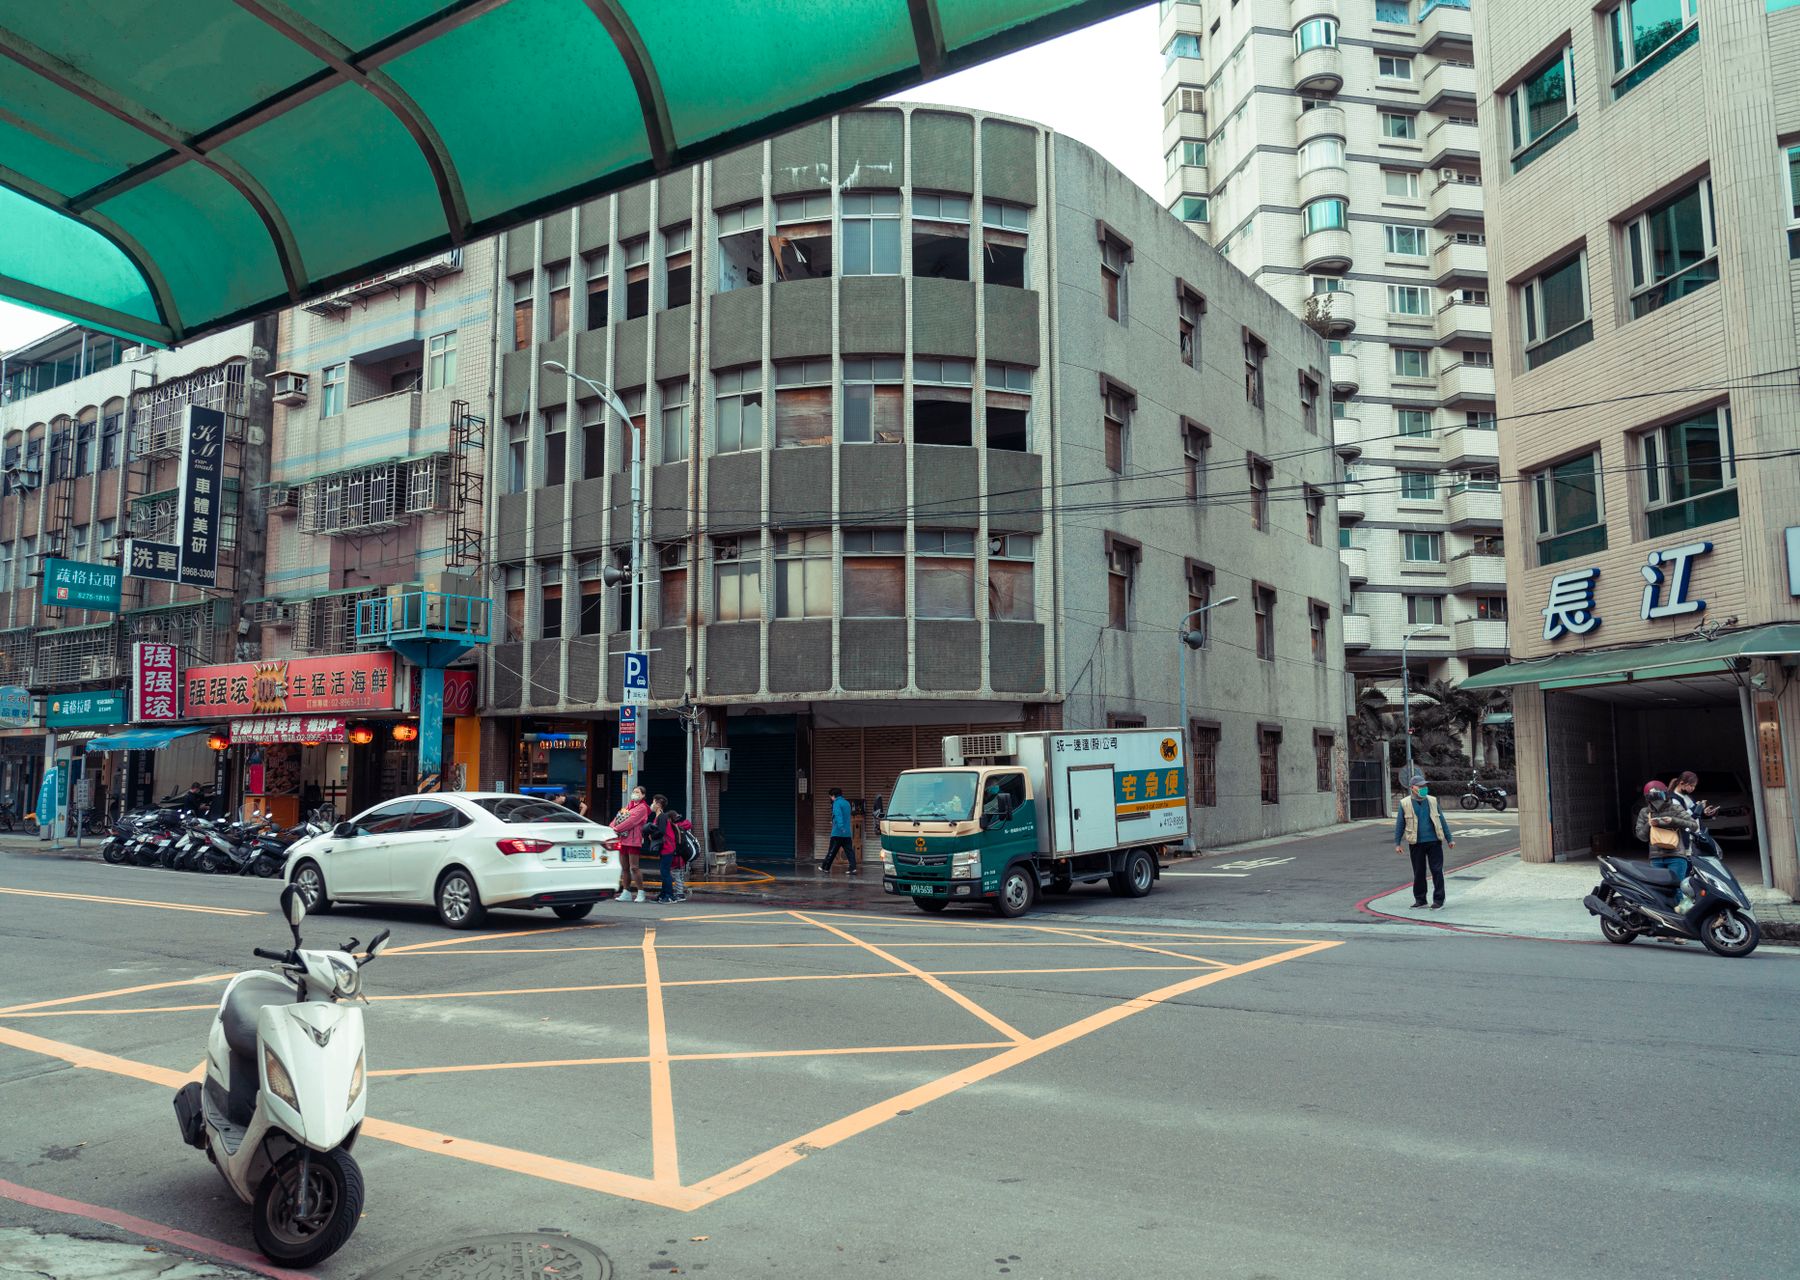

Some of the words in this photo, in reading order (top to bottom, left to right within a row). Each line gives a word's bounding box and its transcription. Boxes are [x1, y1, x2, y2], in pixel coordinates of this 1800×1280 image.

[191, 477, 211, 554] 車體美研
[132, 546, 177, 572] 洗車
[181, 566, 215, 579] 8968-3300
[1541, 542, 1712, 640] 長江
[626, 656, 641, 685] P
[1122, 769, 1179, 800] 宅急便
